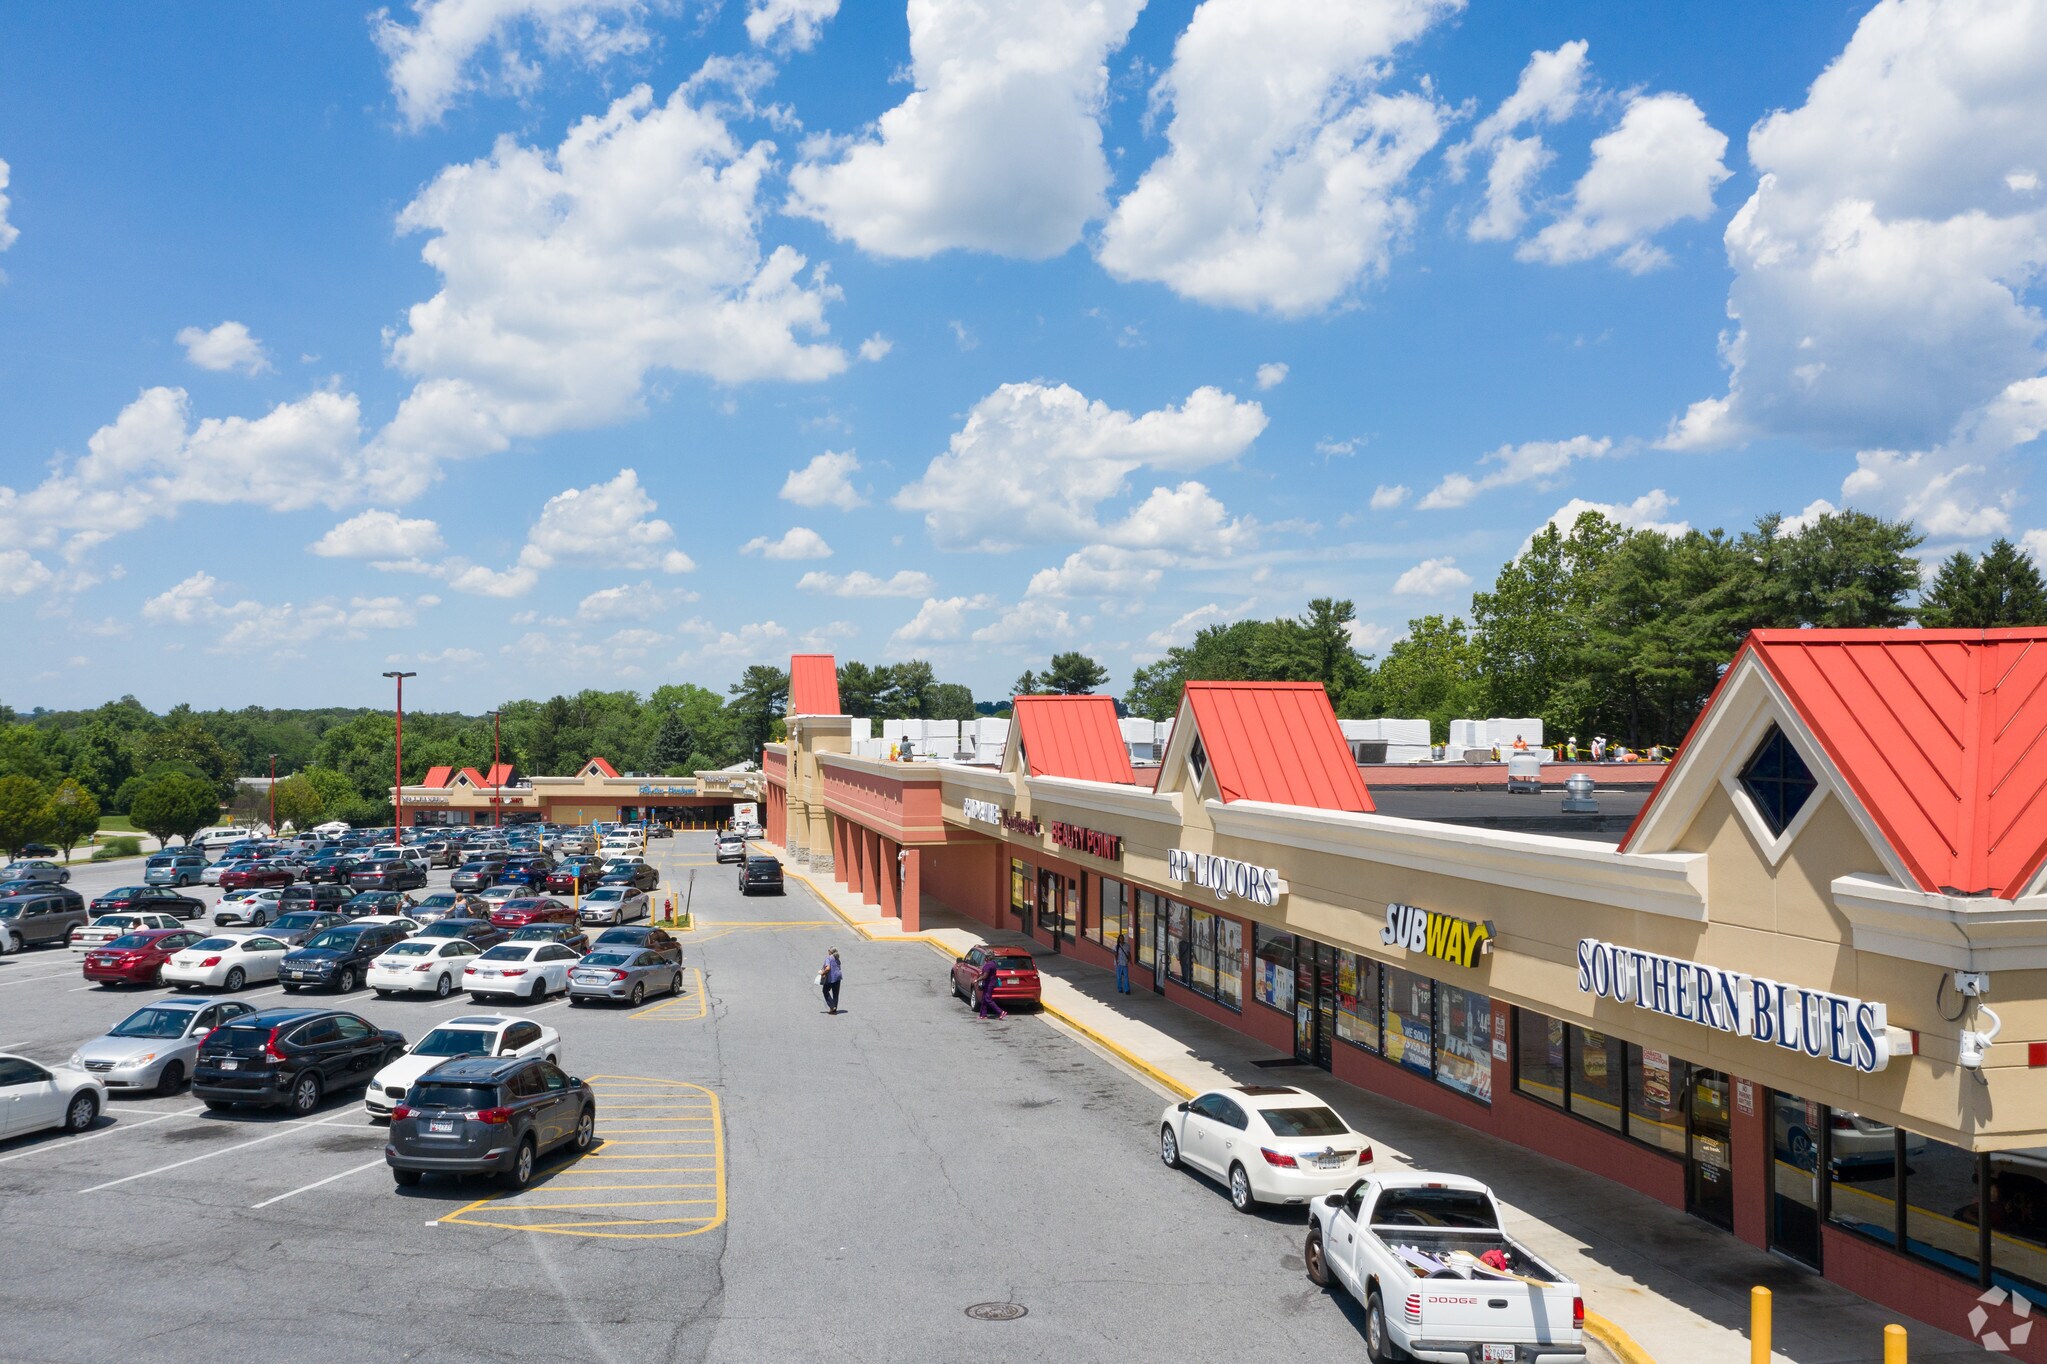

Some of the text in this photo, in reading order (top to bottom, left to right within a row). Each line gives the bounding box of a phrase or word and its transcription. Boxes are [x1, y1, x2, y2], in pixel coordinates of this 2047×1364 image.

[1052, 820, 1087, 851] BEAUTY
[1087, 829, 1120, 862] POINT
[1168, 849, 1278, 906] RP LIQUORS
[1382, 903, 1490, 968] SUBWAY
[1577, 938, 1888, 1073] SOUTHERN BLUES
[1428, 1296, 1478, 1304] DODGE
